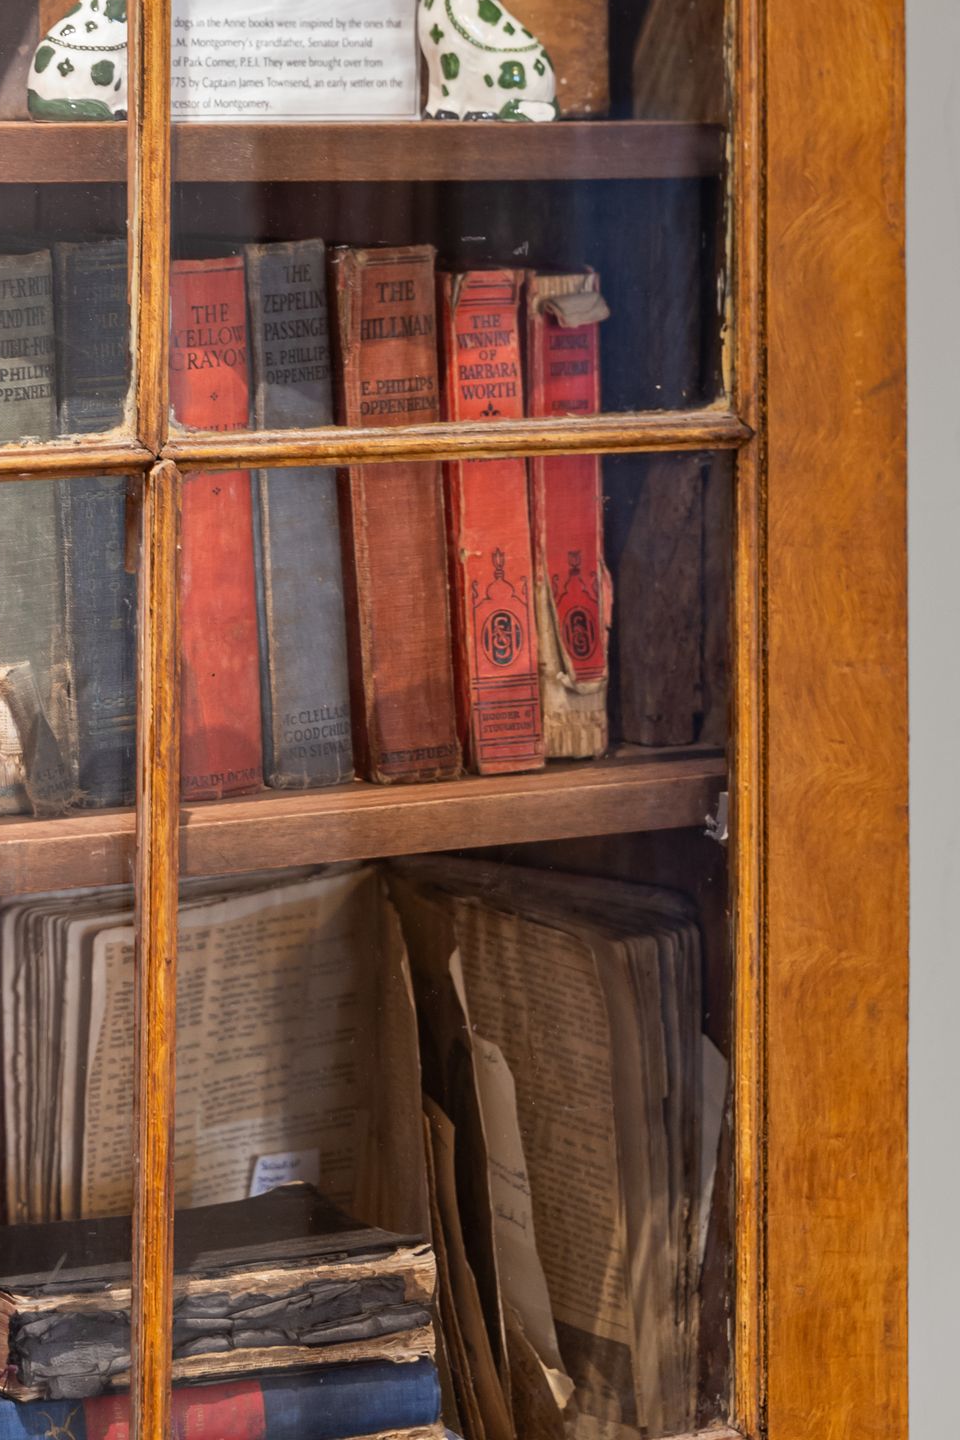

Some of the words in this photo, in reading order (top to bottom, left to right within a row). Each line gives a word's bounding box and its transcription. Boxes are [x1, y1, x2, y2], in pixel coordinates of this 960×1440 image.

[174, 17, 194, 30] dogs
[207, 17, 221, 28] the
[248, 17, 275, 28] books
[348, 18, 362, 28] the
[385, 18, 402, 28] that
[183, 56, 202, 67] Park
[263, 57, 283, 70] They
[286, 59, 307, 68] were
[344, 59, 362, 68] over
[201, 77, 237, 90] Captain
[389, 78, 404, 88] the
[283, 264, 312, 284] THE
[375, 280, 416, 304] THE
[191, 303, 229, 325] THE
[470, 314, 501, 329] THE
[263, 317, 328, 342] PASSENGE
[360, 314, 433, 341] HILLMAN
[478, 349, 497, 361] OF
[459, 362, 518, 380] BARBARA
[461, 382, 517, 400] WORTH
